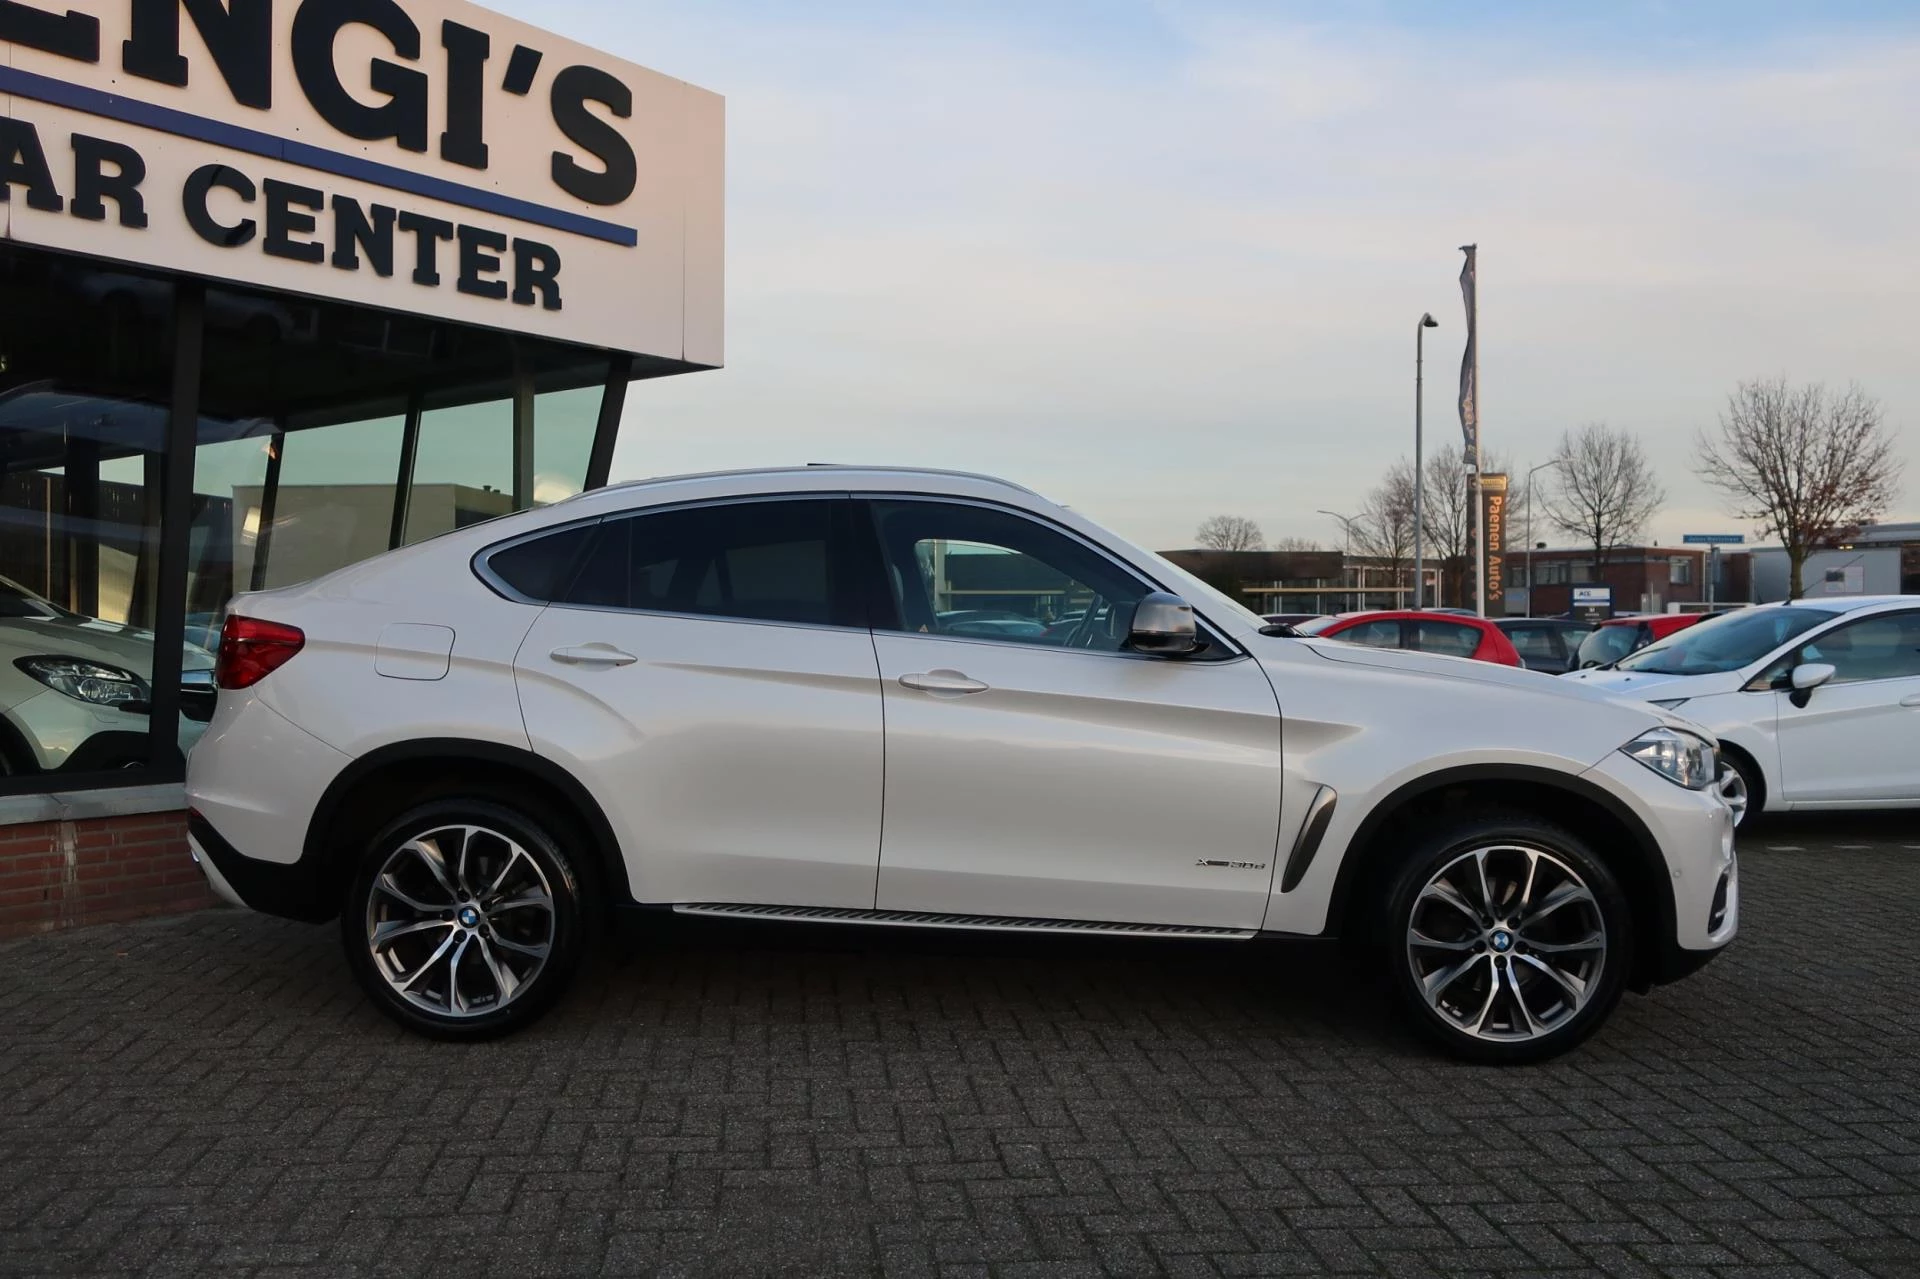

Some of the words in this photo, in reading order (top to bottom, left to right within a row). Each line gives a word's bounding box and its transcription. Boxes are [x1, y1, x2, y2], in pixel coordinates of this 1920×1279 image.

[0, 0, 637, 206] NGI'S
[182, 164, 562, 310] CENTER
[1489, 496, 1502, 551] Paenen
[1488, 555, 1503, 601] Auto's
